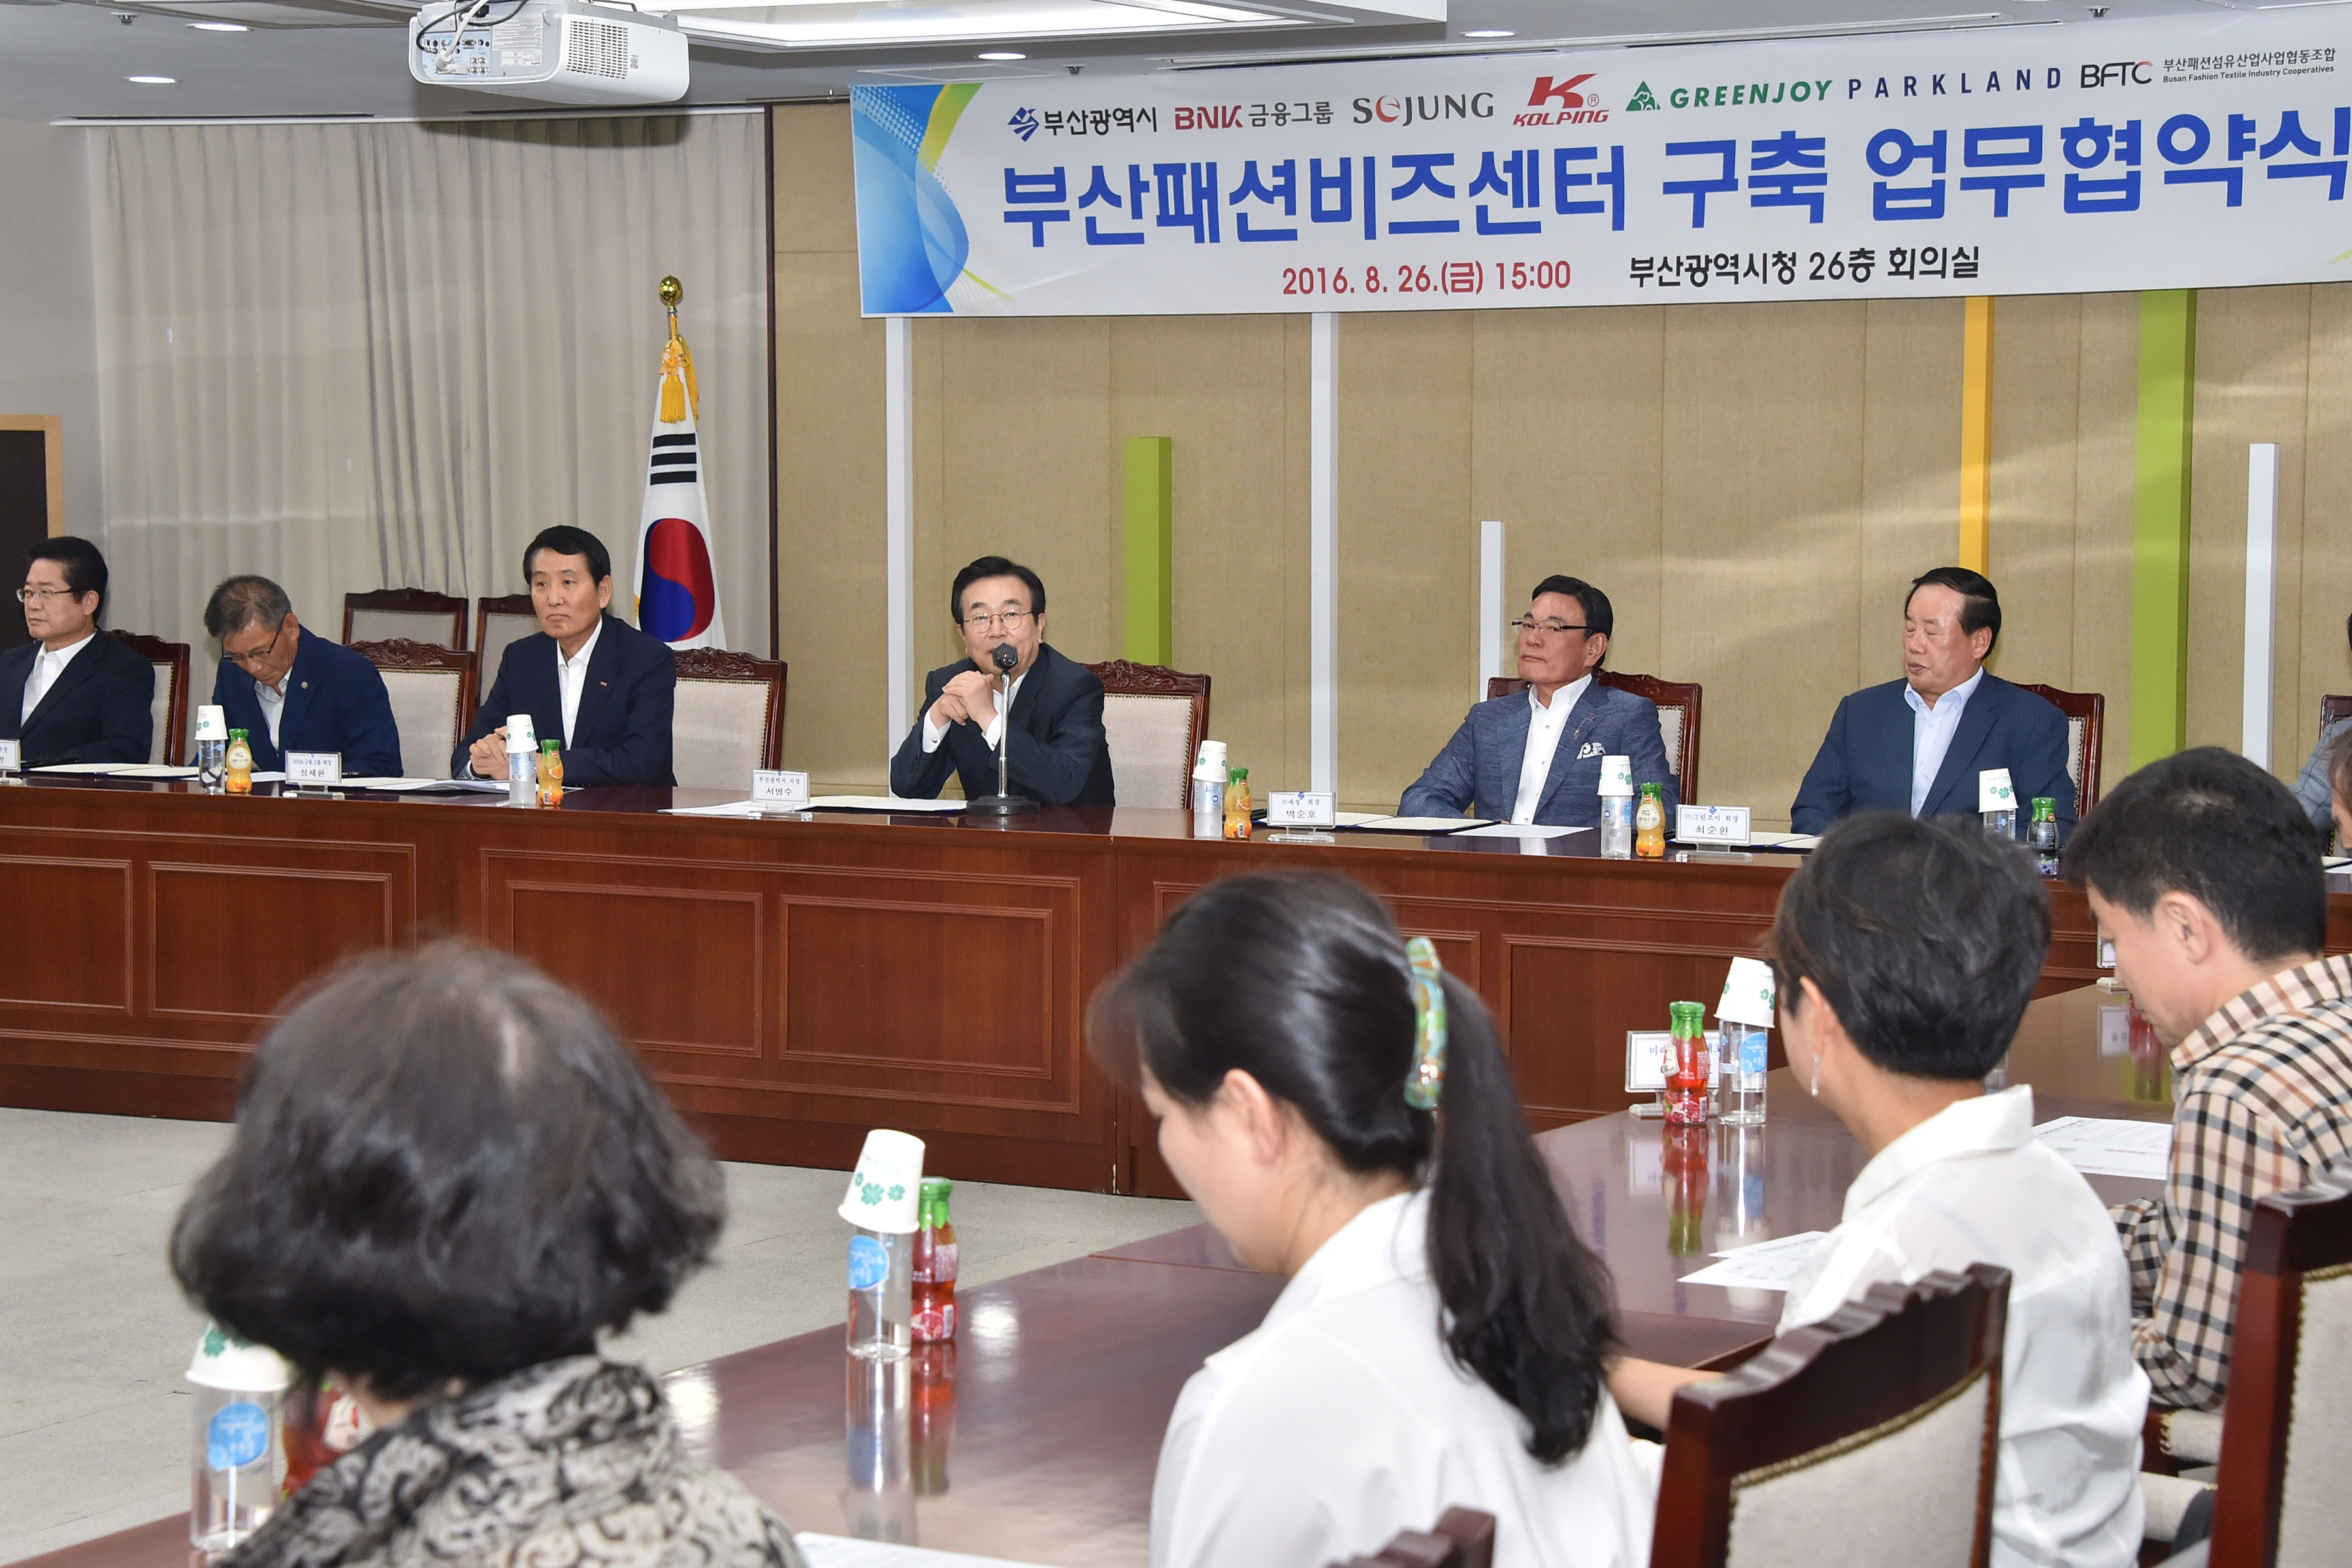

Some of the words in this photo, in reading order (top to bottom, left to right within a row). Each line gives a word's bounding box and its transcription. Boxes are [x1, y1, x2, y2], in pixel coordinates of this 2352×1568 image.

[2163, 48, 2337, 72] 부산패션섬유산업사업협동조합
[1849, 68, 2061, 100] PARKLAND
[2081, 61, 2153, 89] BFTC
[2163, 75, 2186, 84] Busan
[2189, 73, 2218, 82] Fashion
[2220, 71, 2246, 80] Textile
[2248, 69, 2281, 78] Industry
[2283, 65, 2334, 76] Cooperatives
[1671, 80, 1833, 109] GREENJOY
[1045, 107, 1158, 136] 부산광역시
[1175, 105, 1243, 130] BNK
[1249, 102, 1334, 127] 금융그룹
[1513, 109, 1610, 127] KOLPING
[1004, 146, 1625, 248] 부산패션비즈센터
[1663, 131, 1828, 229] 구축
[1866, 106, 2351, 221] 업무협약식
[1283, 267, 1355, 295] 2016.
[1366, 266, 1388, 293] 8.
[1398, 261, 1483, 296] 26.(금)
[1496, 261, 1571, 290] 15:00
[1630, 251, 1797, 288] 부산광역시청
[1810, 248, 1876, 284] 26층
[1887, 246, 1979, 280] 회의실
[1286, 809, 1317, 819] 박순호
[1725, 815, 1739, 823] 회장
